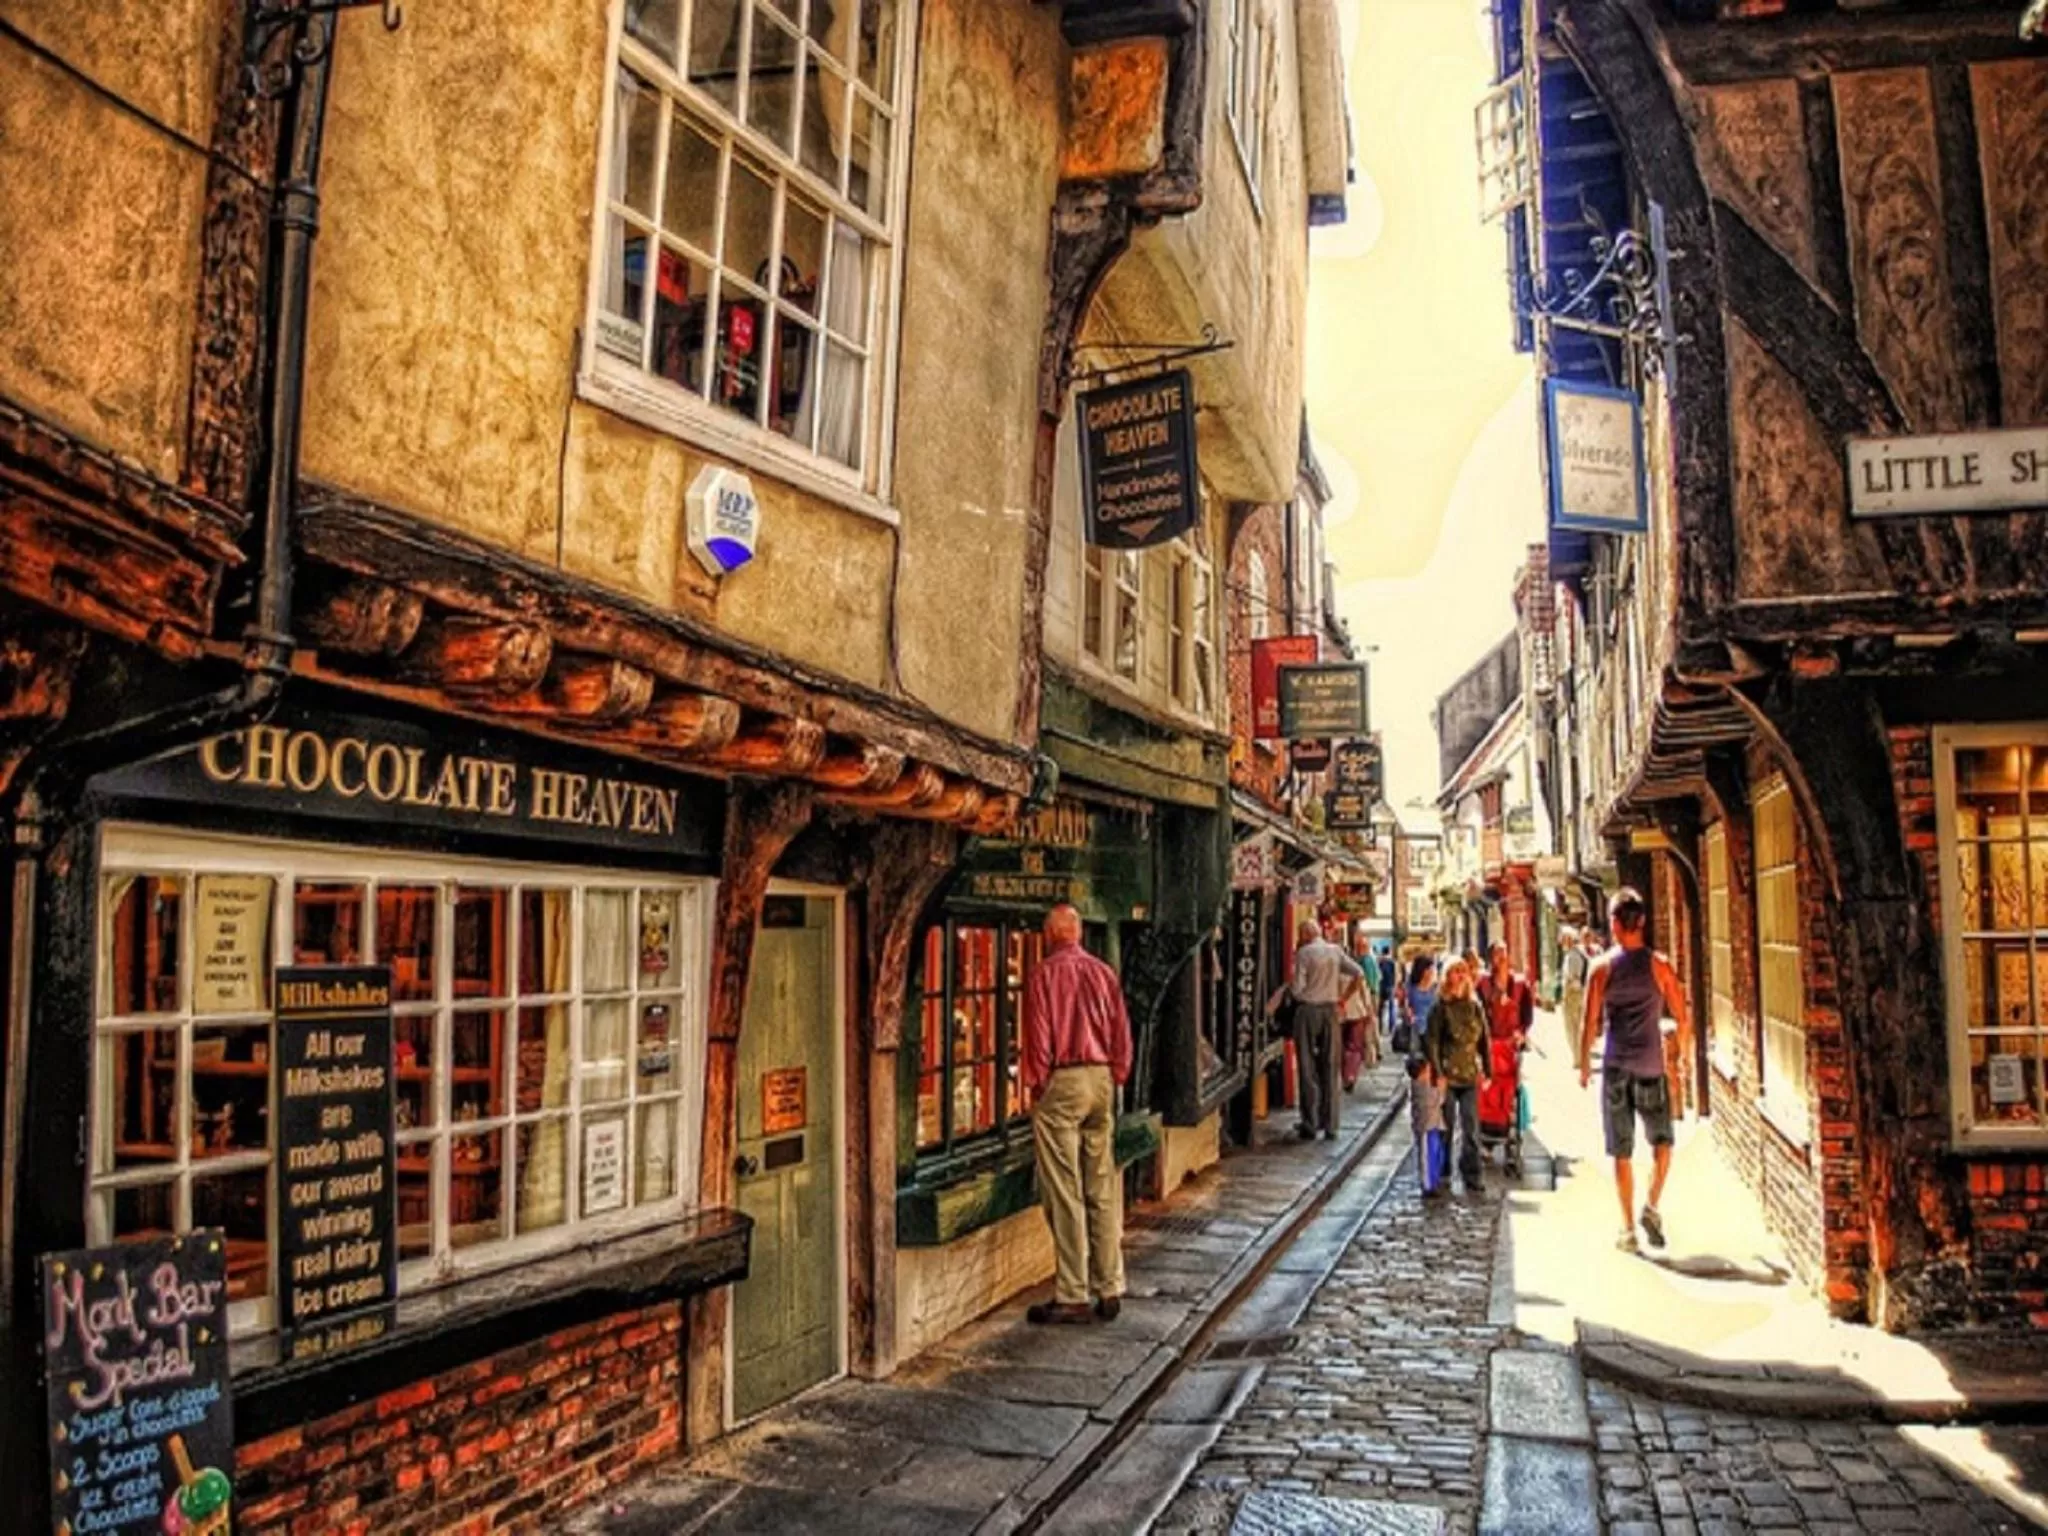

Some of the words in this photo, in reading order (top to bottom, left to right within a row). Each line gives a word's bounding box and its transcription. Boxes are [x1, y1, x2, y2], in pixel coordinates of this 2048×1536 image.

[1088, 387, 1182, 431] CHOCOLATE
[1104, 421, 1169, 456] HEAVEN
[1097, 470, 1182, 501] Handmade
[1863, 452, 1982, 493] LITTLE
[201, 724, 517, 815] CHOCOLATE
[530, 766, 678, 835] HEAVEN
[280, 981, 389, 1009] Milkshakes
[305, 1030, 331, 1059] All
[335, 1034, 365, 1056] our
[285, 1064, 385, 1096] Milkshakes
[321, 1104, 353, 1129] are
[287, 1137, 340, 1169] made
[344, 1130, 384, 1160] with
[290, 1179, 322, 1207] our
[328, 1165, 383, 1200] award
[302, 1206, 374, 1241] winning
[292, 1245, 332, 1280] real
[335, 1238, 382, 1271] dairy
[149, 1262, 222, 1325] Bar
[292, 1285, 323, 1316] ice
[327, 1275, 385, 1309] cream
[74, 1322, 196, 1409] Special
[72, 1456, 91, 1487] 2
[96, 1442, 161, 1480] Scoops
